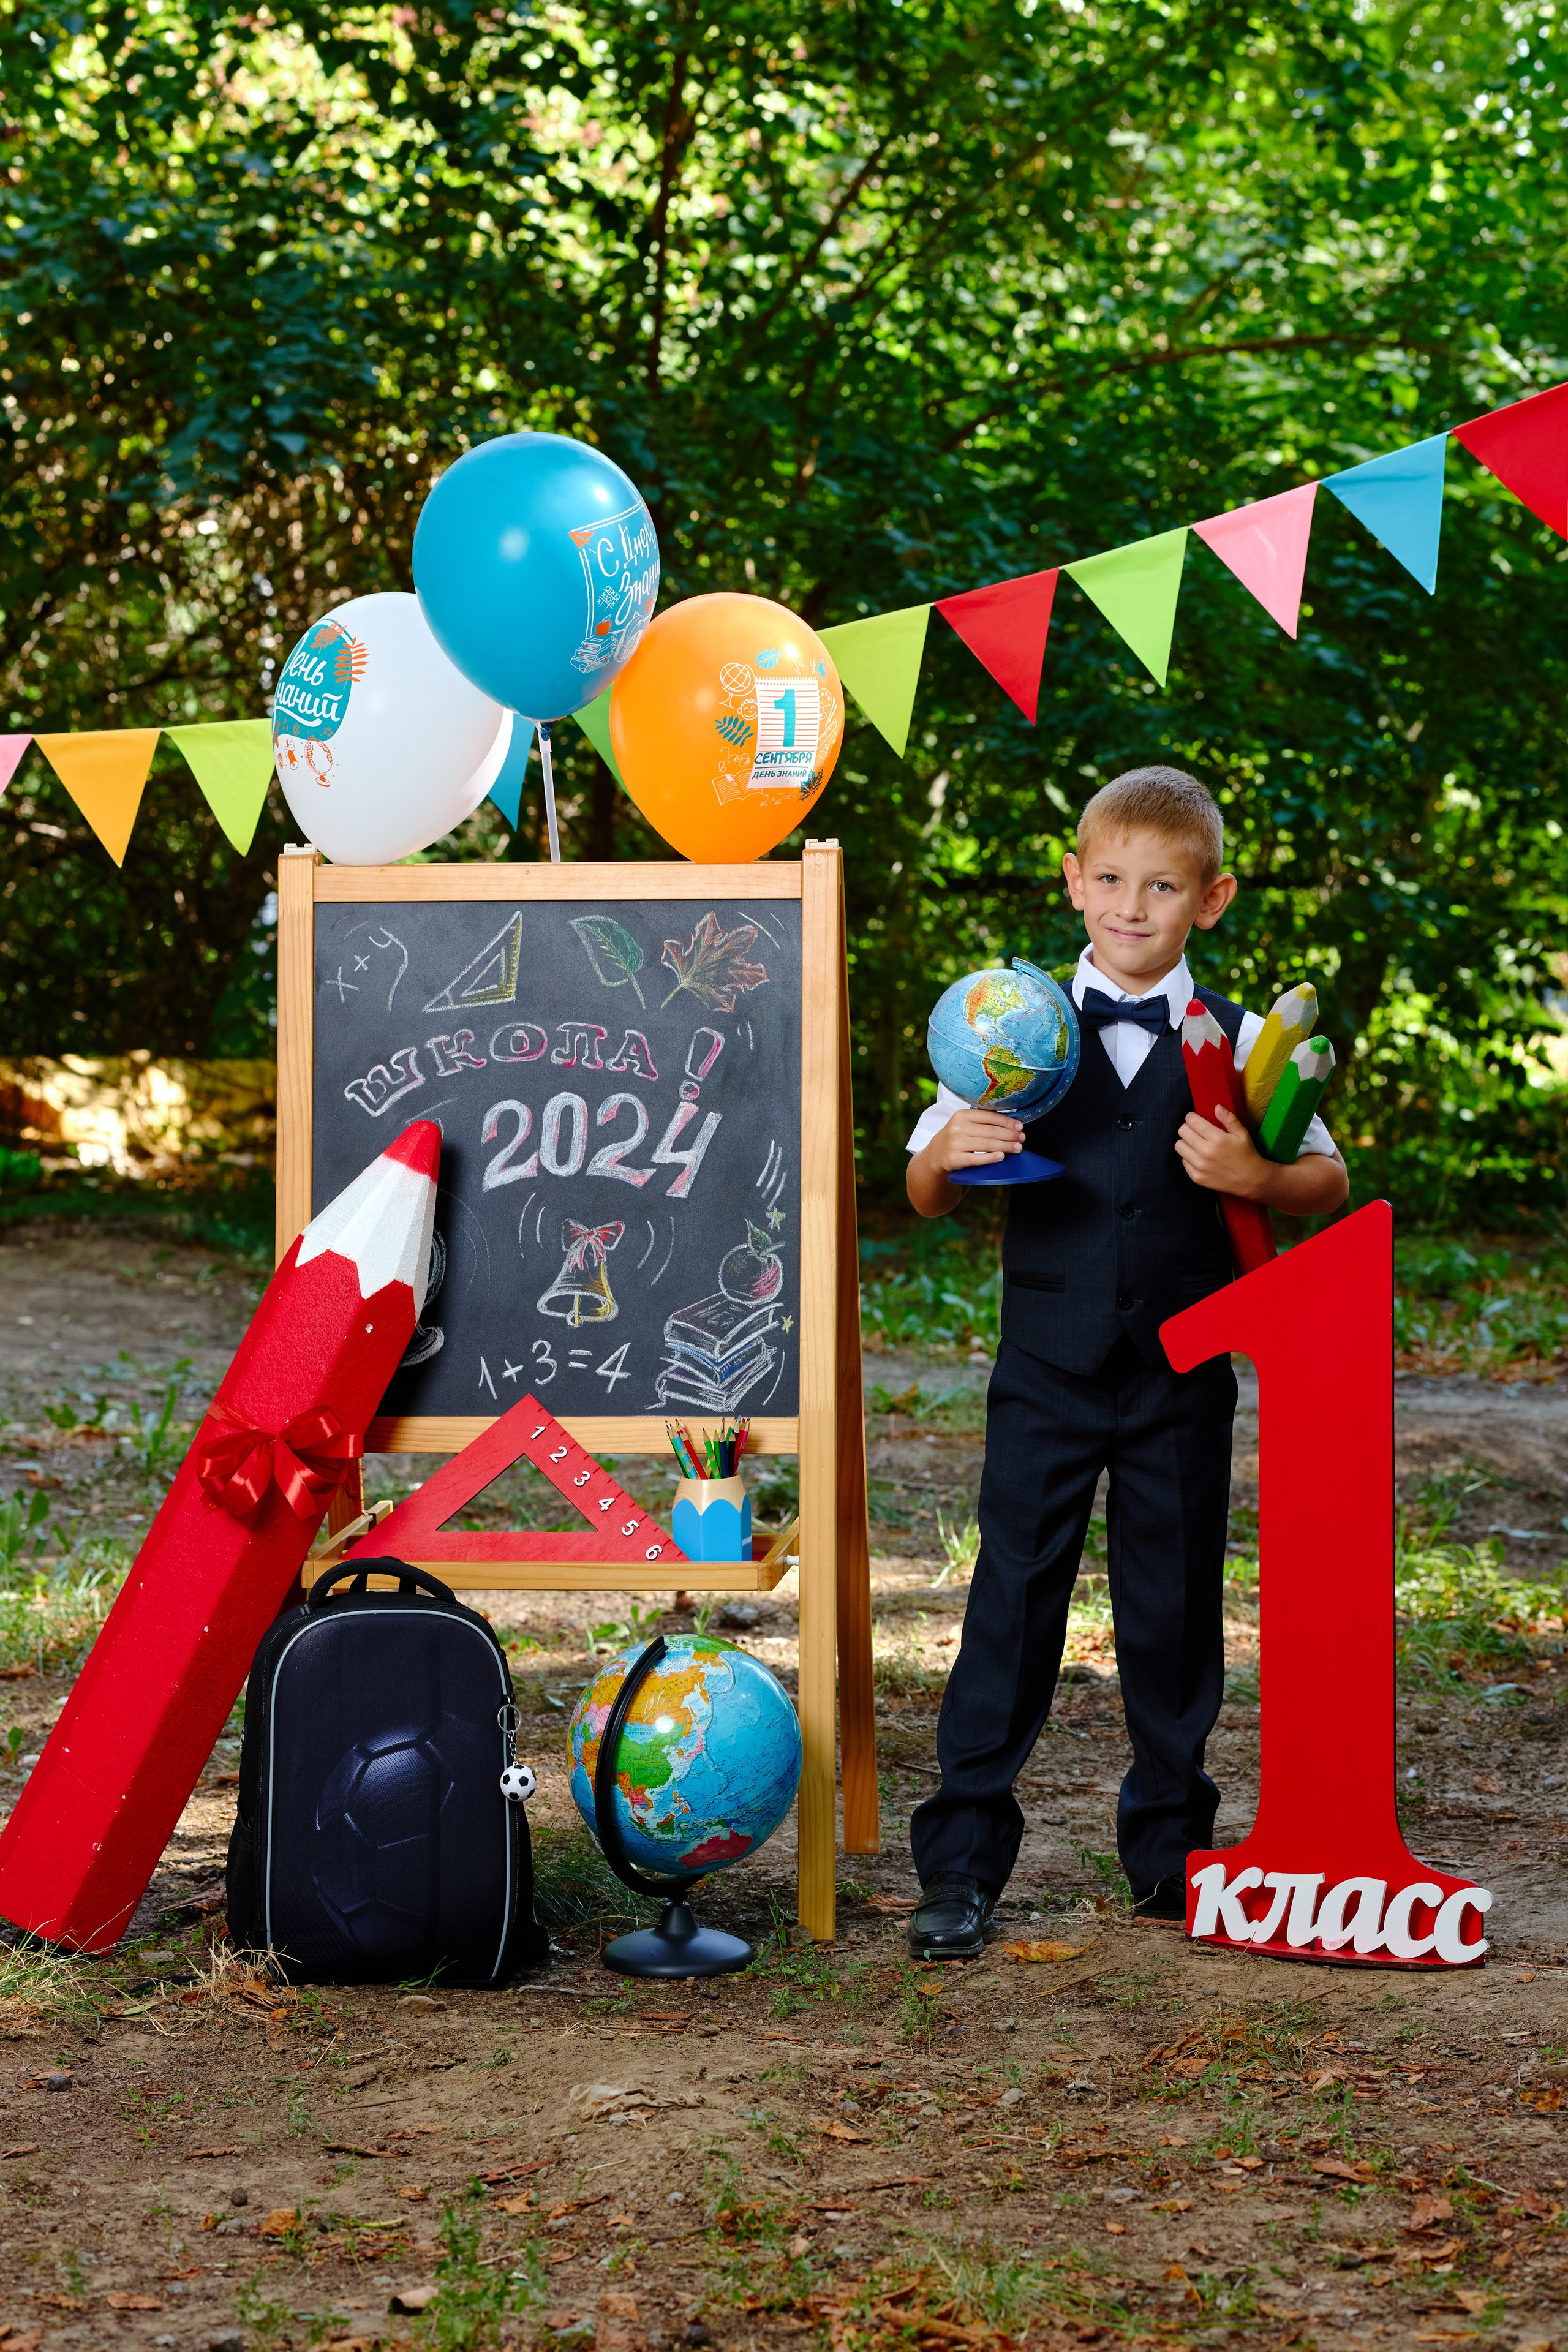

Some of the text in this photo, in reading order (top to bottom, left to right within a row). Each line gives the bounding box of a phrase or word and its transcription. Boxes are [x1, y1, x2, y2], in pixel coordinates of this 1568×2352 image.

[275, 680, 341, 722] наний
[774, 689, 796, 747] 1
[752, 769, 807, 780] ДЕНЬ ЗНАНИЙ
[754, 750, 813, 765] СЕНТЯБРЯ
[481, 1091, 723, 1199] 2024
[530, 1425, 663, 1561] 1 2 3 4 5 6
[1190, 1863, 1494, 1964] класс
